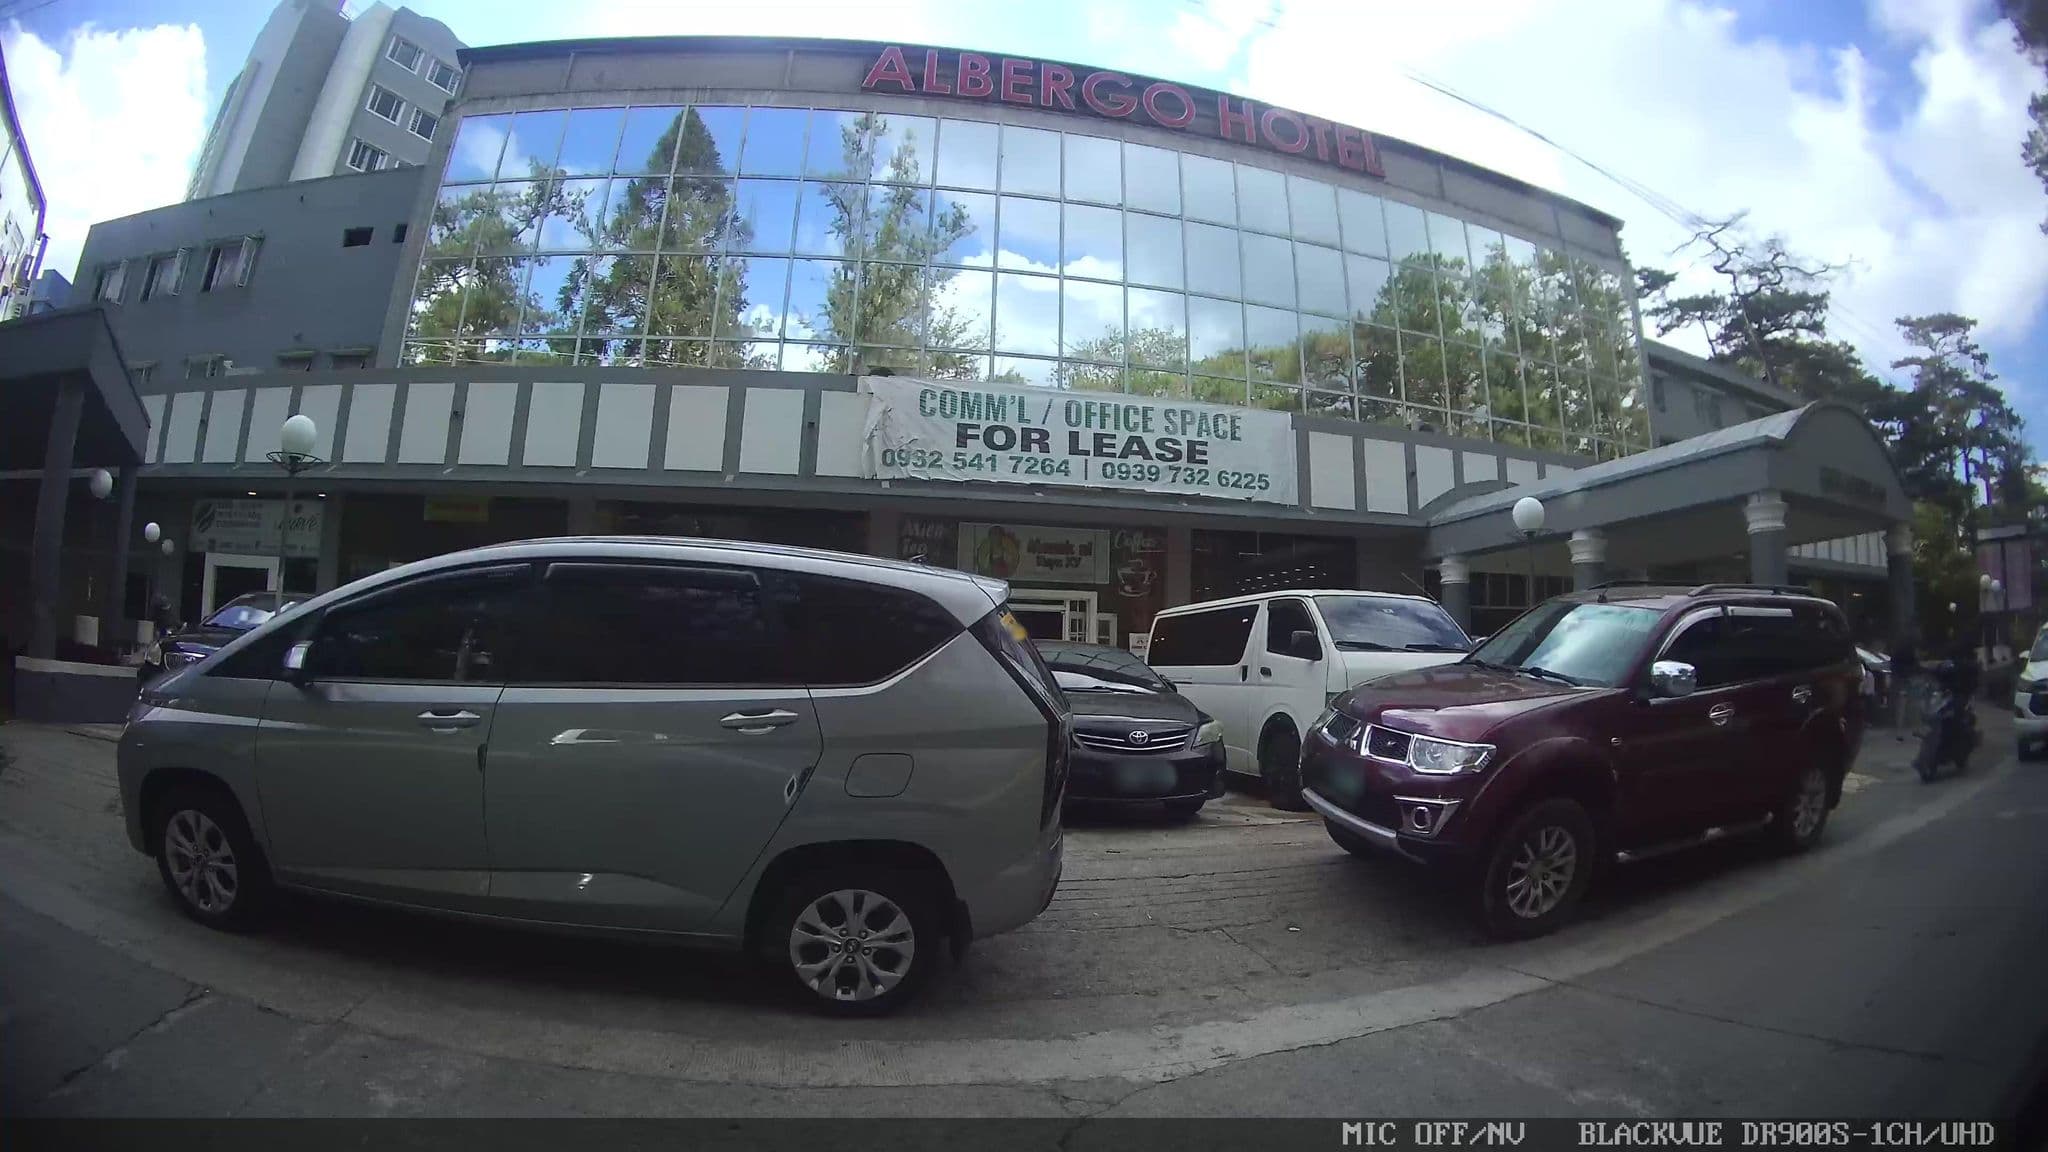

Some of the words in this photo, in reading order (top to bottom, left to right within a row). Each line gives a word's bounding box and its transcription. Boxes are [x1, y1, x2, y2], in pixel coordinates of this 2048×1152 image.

[861, 46, 1196, 128] ALBERGO
[1218, 95, 1386, 177] HOTEL
[919, 388, 1031, 424] COMM'L
[1042, 398, 1054, 425] /
[1065, 400, 1155, 433] OFFICE
[1163, 408, 1242, 442] SPACE
[956, 422, 1050, 454] FOR
[1068, 430, 1208, 465] LEASE
[881, 448, 944, 469] 0932
[952, 452, 998, 472] 541
[1009, 455, 1071, 477] 7264
[1102, 462, 1160, 482] 0939
[1168, 464, 1210, 486] 732
[1217, 470, 1270, 490] 6225
